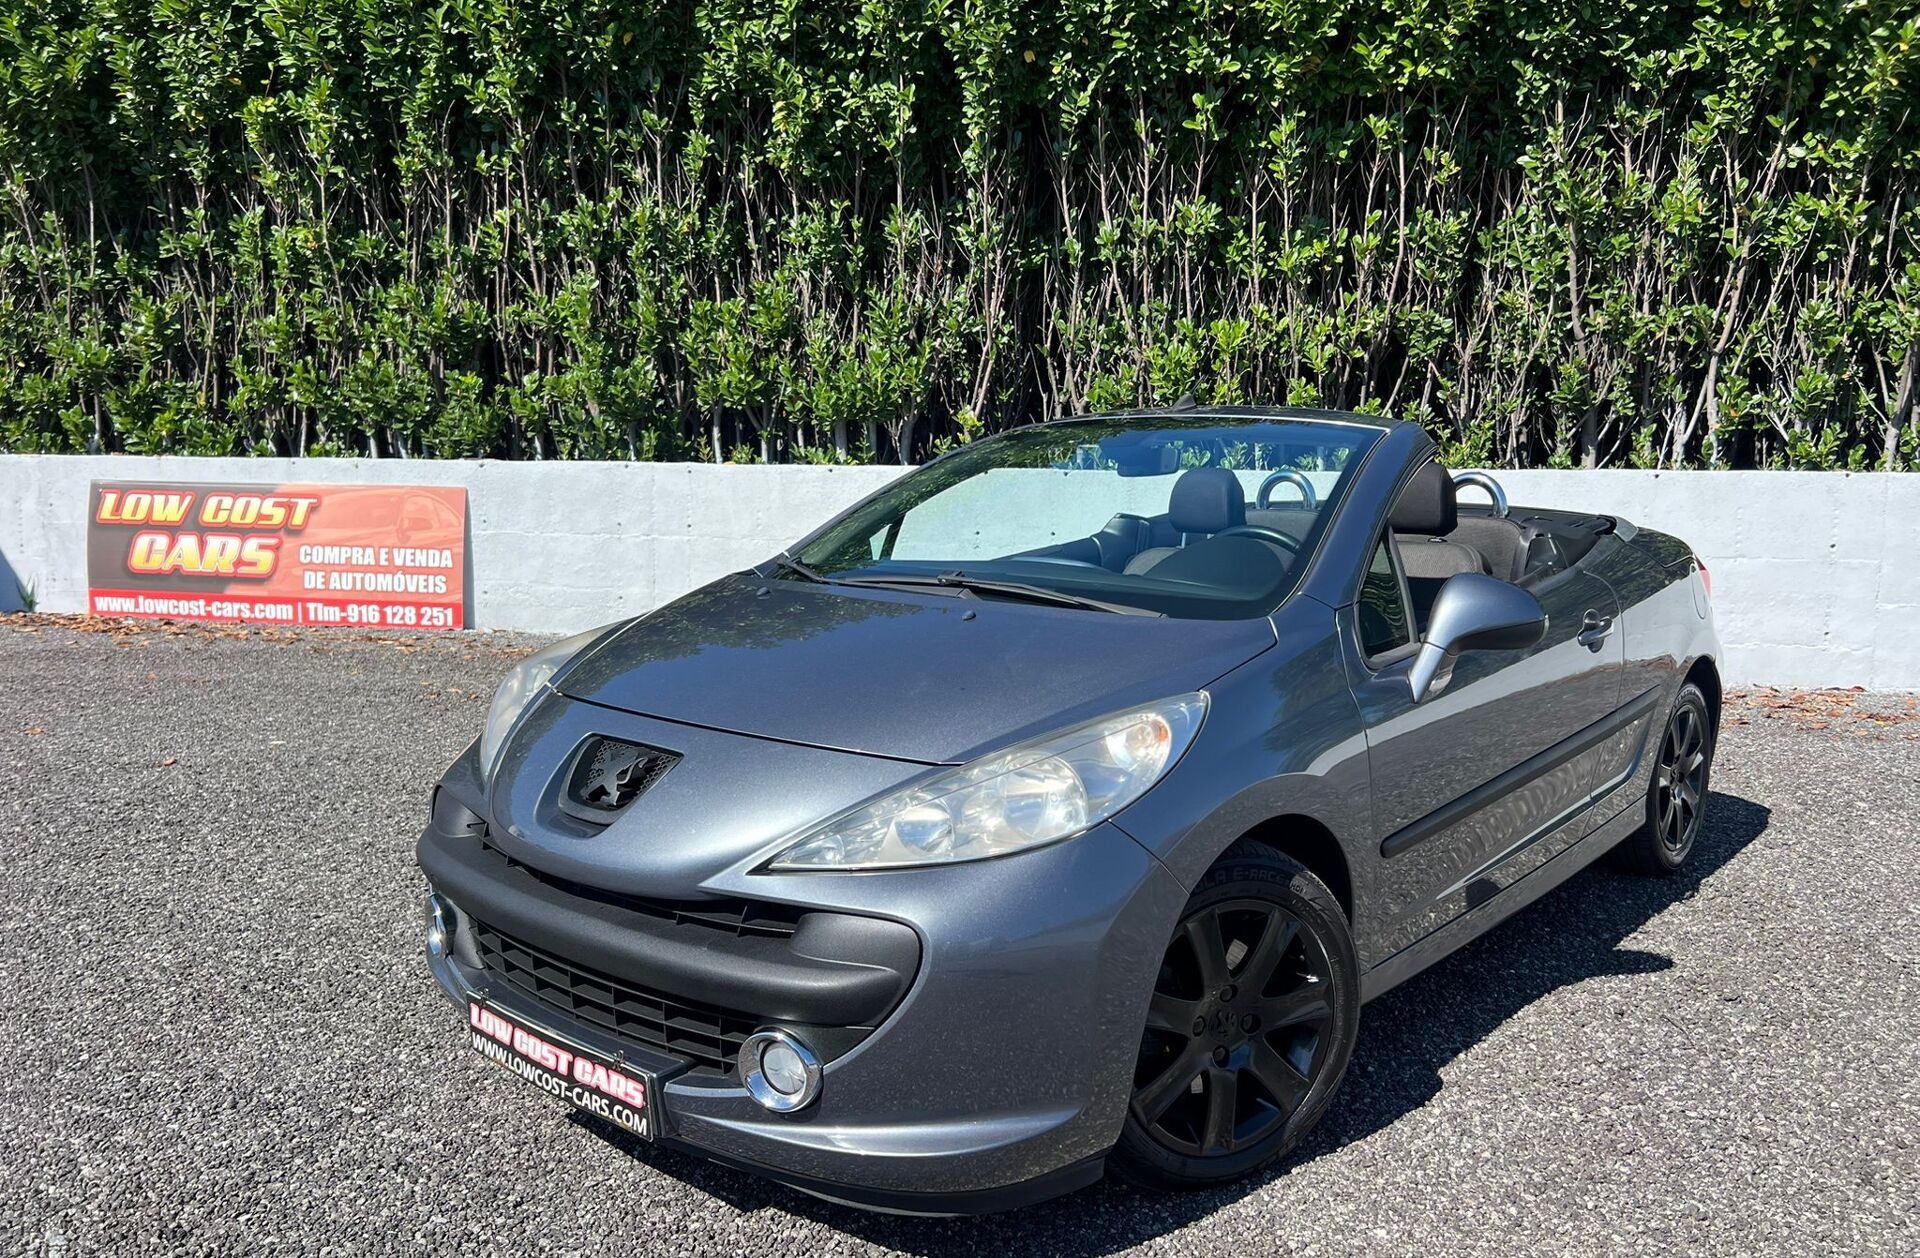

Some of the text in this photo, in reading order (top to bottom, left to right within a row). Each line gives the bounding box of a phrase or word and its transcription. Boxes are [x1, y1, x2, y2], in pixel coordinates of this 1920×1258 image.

[98, 491, 318, 527] LOW COST
[130, 532, 281, 575] CARS
[299, 545, 453, 568] COMPRA E VENDA
[304, 571, 447, 593] DE AUTOMÓVEIS
[94, 596, 453, 626] www.lowcost-cars.com Tlm-916 128 251
[470, 1003, 646, 1109] LOW COST CARS
[471, 1031, 648, 1136] WWW.LOWCOST-CARS.COM
